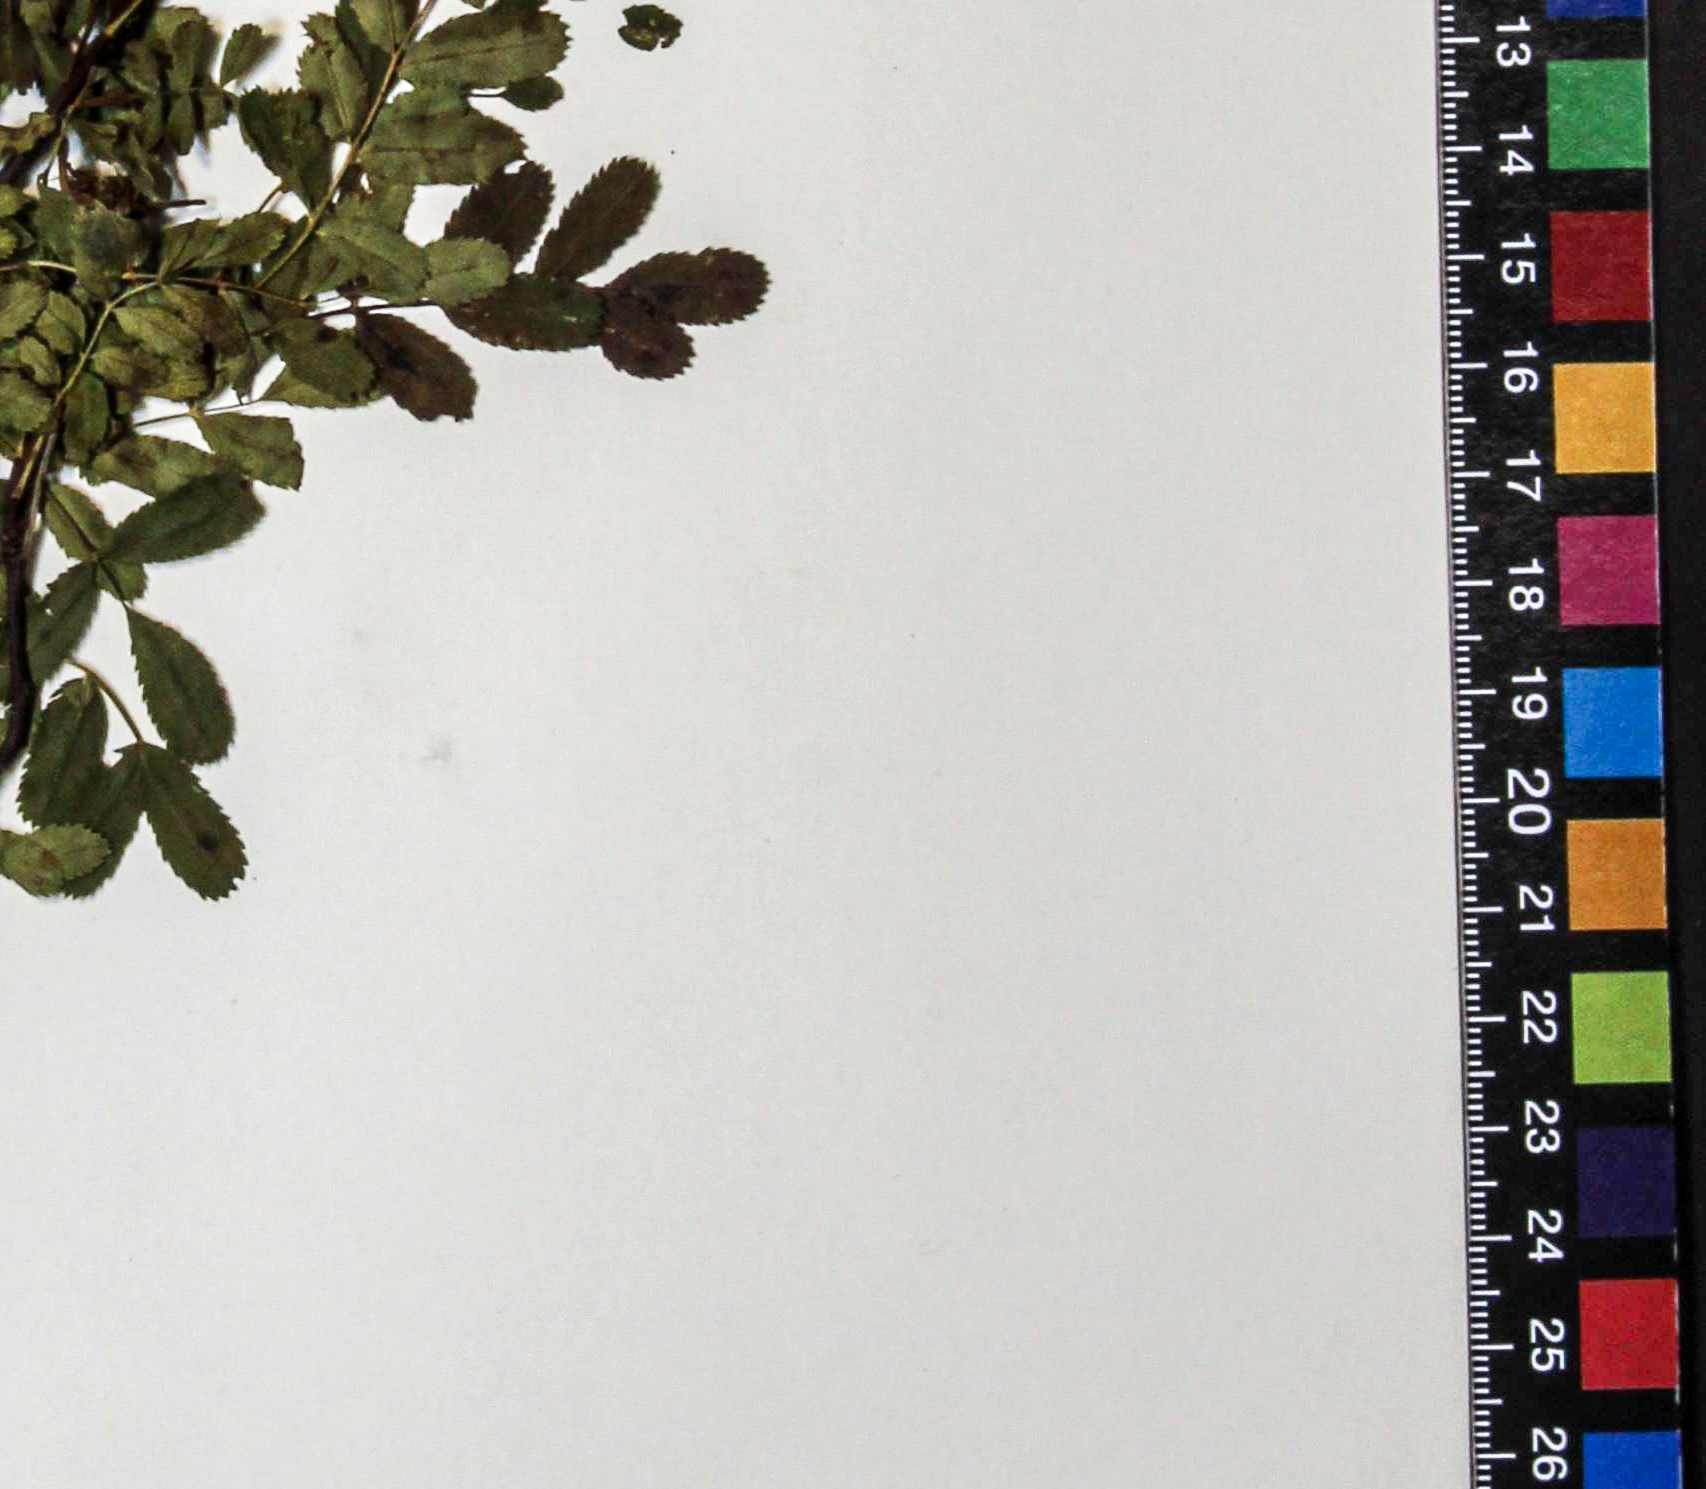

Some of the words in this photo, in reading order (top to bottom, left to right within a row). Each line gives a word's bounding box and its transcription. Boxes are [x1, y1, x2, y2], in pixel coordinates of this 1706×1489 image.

[1495, 15, 1532, 68] 13
[1498, 124, 1535, 176] 14
[1501, 232, 1537, 285] 15
[1503, 341, 1539, 394] 16
[1505, 449, 1542, 502] 17
[1507, 557, 1545, 612] 18
[1511, 666, 1549, 720] 19
[1506, 767, 1552, 835] 20
[1518, 884, 1555, 931] 21
[1522, 990, 1558, 1044] 22
[1524, 1099, 1561, 1154] 23
[1527, 1209, 1564, 1263] 24
[1529, 1318, 1565, 1372] 25
[1531, 1427, 1568, 1481] 26
